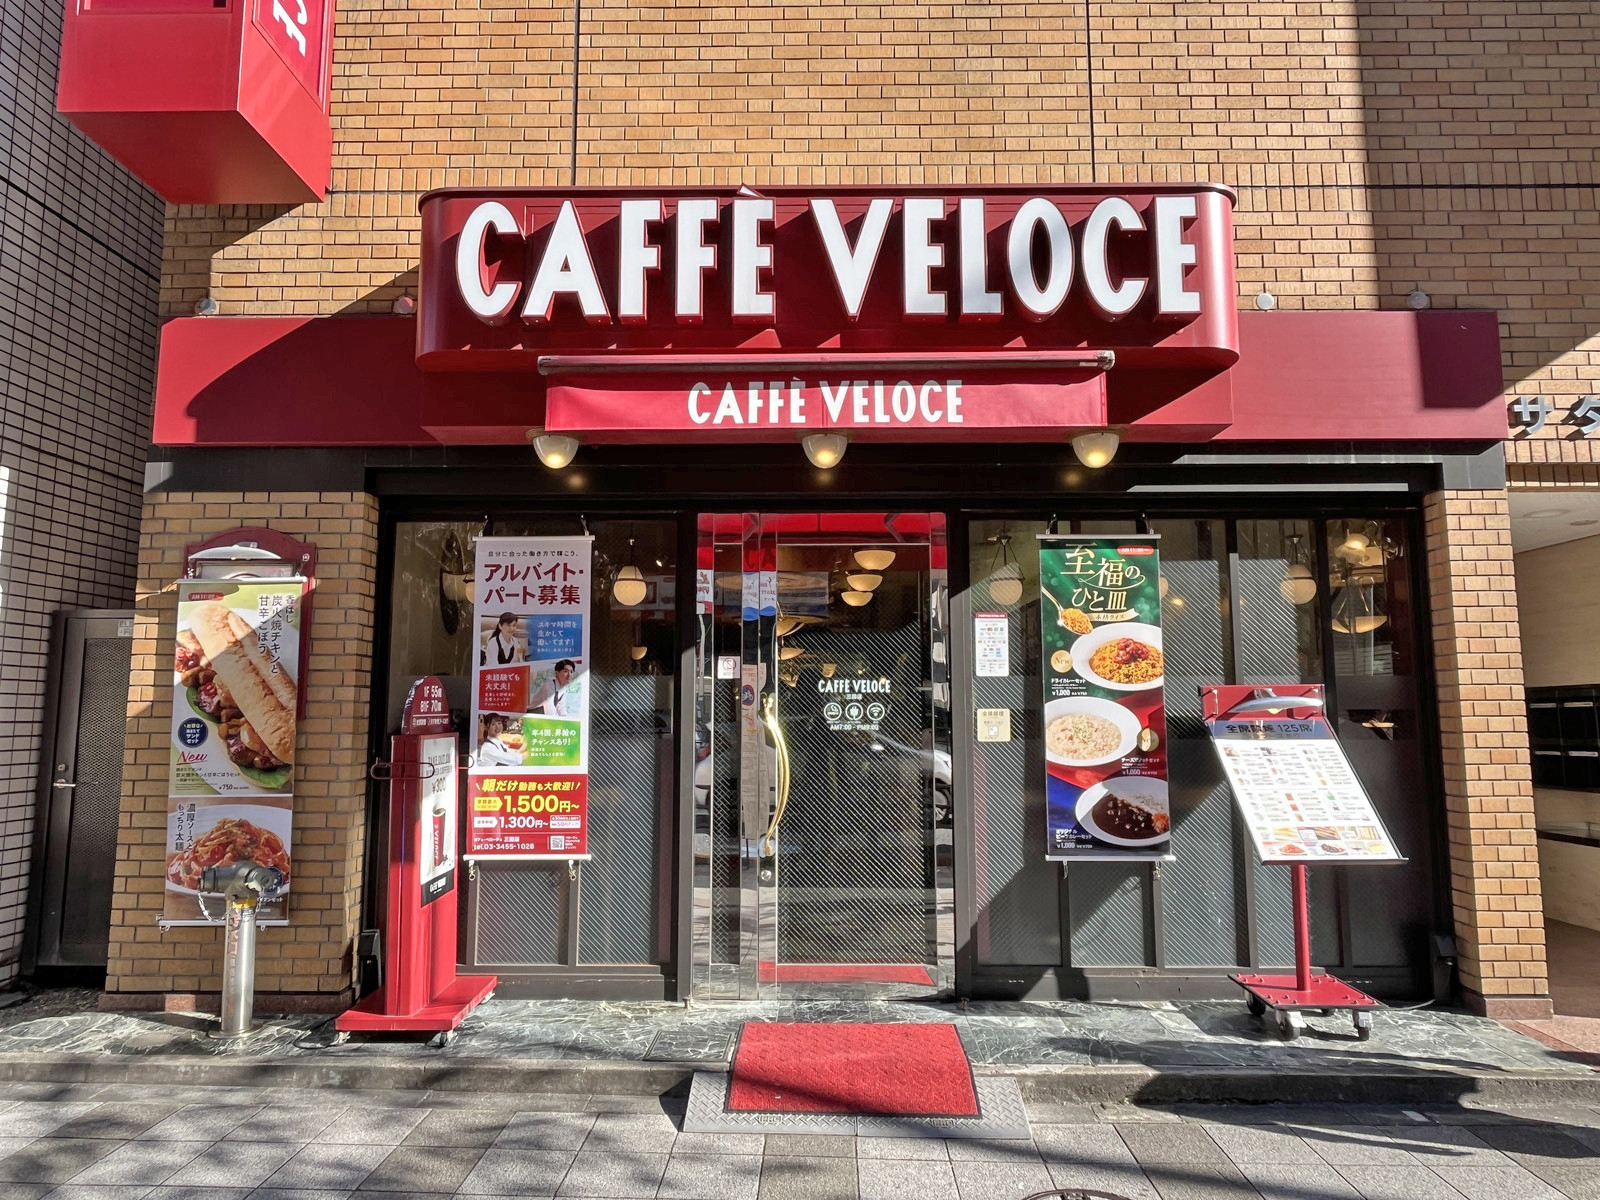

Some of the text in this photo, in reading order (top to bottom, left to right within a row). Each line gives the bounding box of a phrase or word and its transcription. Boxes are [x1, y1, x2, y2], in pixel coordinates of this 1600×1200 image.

[455, 183, 1202, 320] CAFFÈ VELOCE
[687, 376, 964, 425] CAFFÈ VELOCE
[1060, 543, 1141, 587] 至福の
[484, 585, 581, 605] パート募集
[1071, 588, 1127, 612] ひと皿
[257, 595, 270, 655] 甘辛ごぼう
[270, 595, 283, 674] 炭火焼チキンと
[537, 620, 577, 629] スキマ時間を
[485, 673, 520, 681] 未経験でも
[852, 679, 891, 693] VELOCE
[531, 738, 571, 747] チャンスあり!
[177, 750, 208, 763] New
